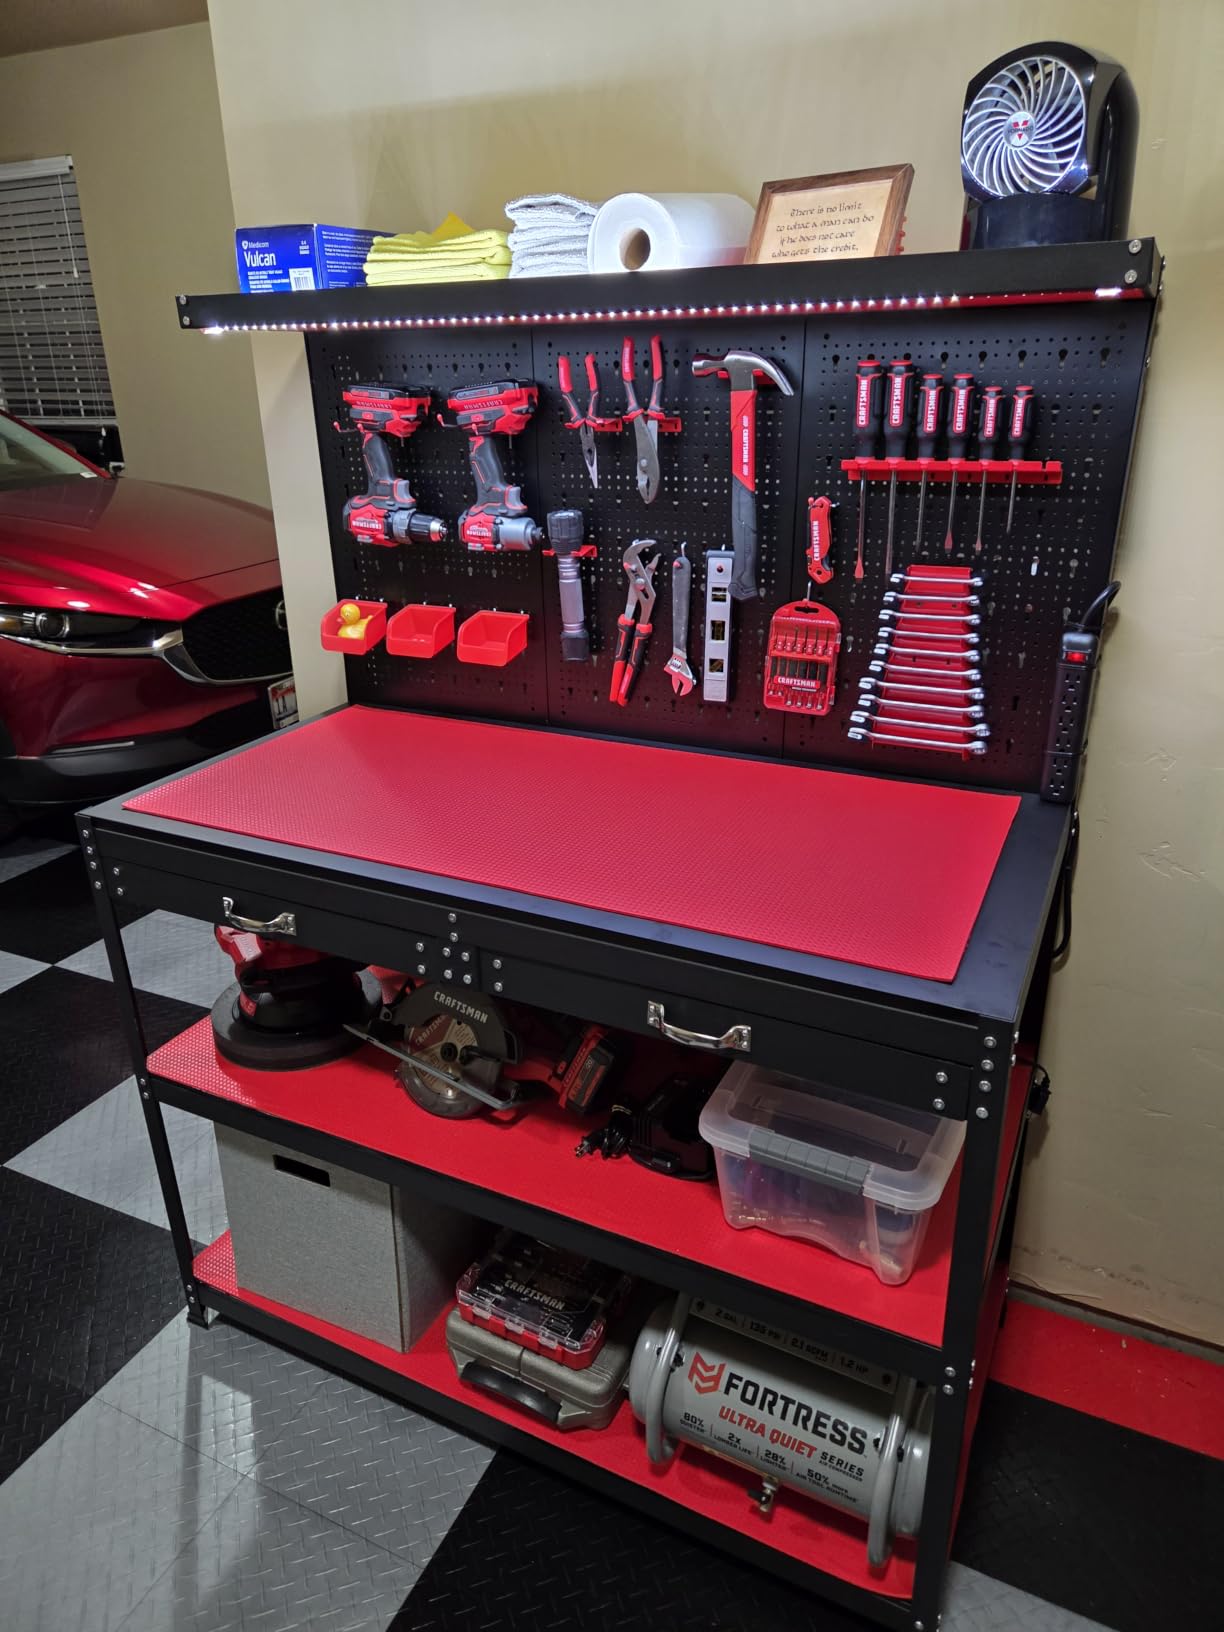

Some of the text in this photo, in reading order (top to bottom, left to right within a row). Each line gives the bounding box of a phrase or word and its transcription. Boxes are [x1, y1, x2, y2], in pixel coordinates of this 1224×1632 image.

[776, 224, 785, 232] to
[786, 220, 811, 231] what
[842, 216, 860, 225] can
[862, 214, 874, 222] do
[790, 207, 815, 217] There
[817, 205, 825, 215] is
[826, 206, 838, 214] no
[771, 248, 791, 258] who
[790, 247, 810, 258] gets
[812, 244, 829, 254] the
[786, 234, 798, 243] he
[798, 234, 817, 242] does
[818, 232, 834, 241] not
[835, 229, 856, 239] care
[243, 250, 277, 268] Vulcan
[858, 379, 868, 426] CRAFTSMAN
[892, 377, 902, 425] CRAFTSMAN
[926, 389, 937, 431] CRAFTSMAN
[955, 388, 966, 431] CRAFTSMAN
[985, 399, 996, 436] CRAFTSMAN
[1013, 399, 1023, 436] CRAFTSMAN
[812, 520, 820, 561] CRAFTSMAN
[777, 677, 816, 687] CRAFTSMAN
[433, 991, 489, 1024] CRAFTSMAN
[503, 1279, 567, 1311] CRAFTSMAN
[683, 1412, 705, 1428] 80%
[723, 1372, 868, 1456] FORTRESS
[719, 1406, 766, 1439] ULTRA
[769, 1428, 818, 1458] QUIET
[820, 1451, 865, 1477] SERIES
[764, 1449, 786, 1465] 28%
[806, 1468, 830, 1485] 50%
